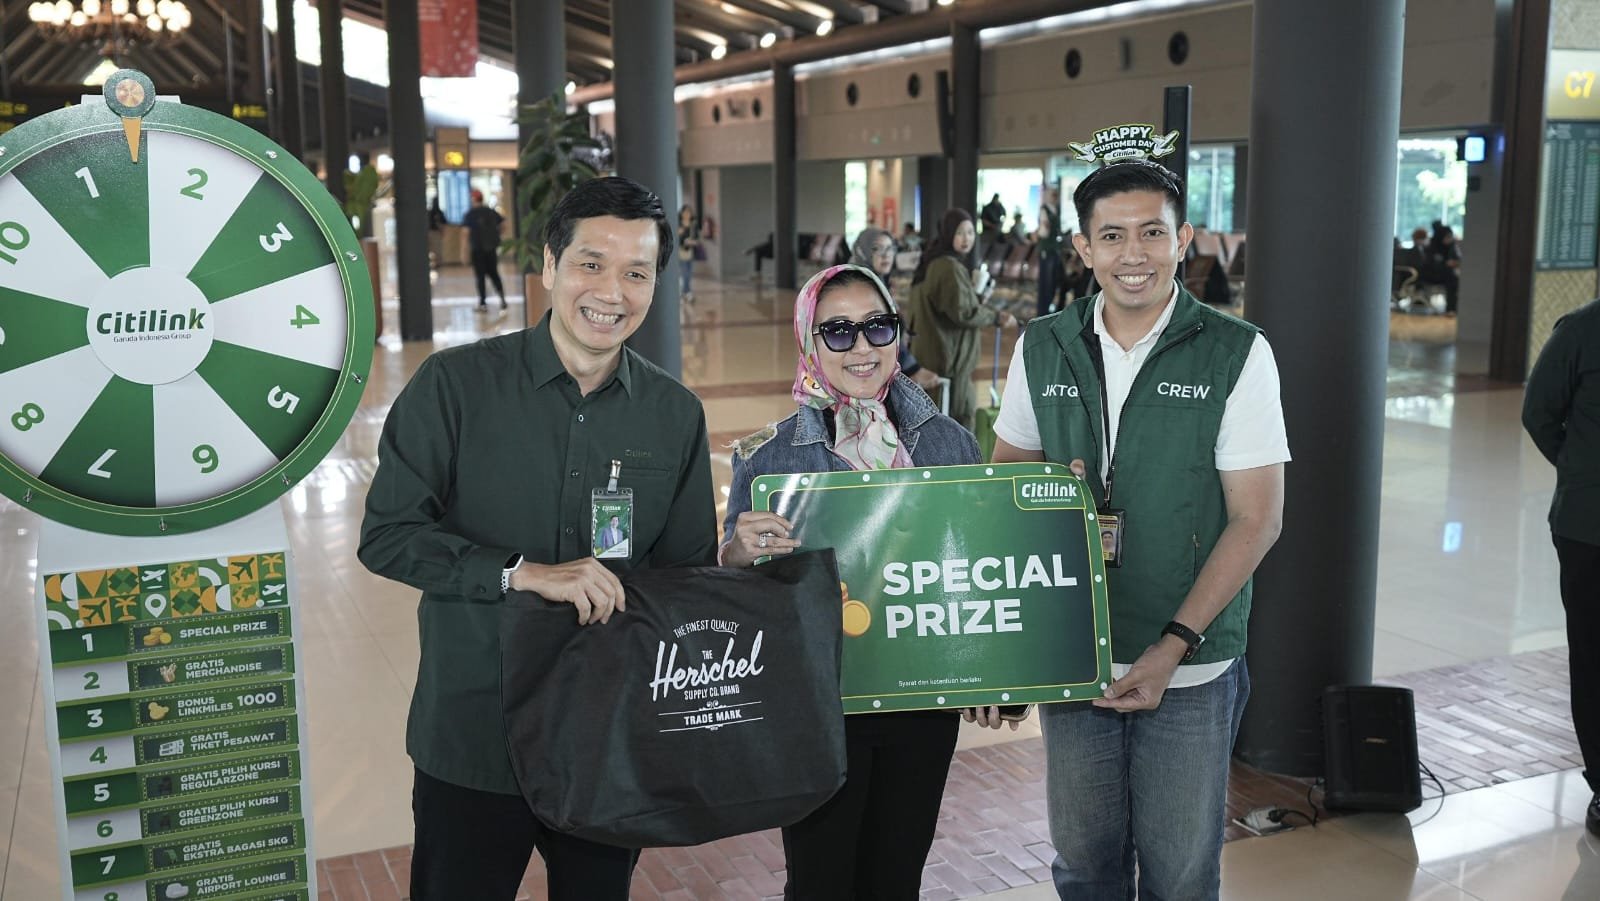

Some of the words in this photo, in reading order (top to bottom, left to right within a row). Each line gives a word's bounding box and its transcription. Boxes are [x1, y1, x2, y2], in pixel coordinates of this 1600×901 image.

[1564, 70, 1596, 98] C7
[1096, 126, 1151, 144] HAPPY
[1093, 139, 1137, 153] CUSTOMER
[1138, 140, 1155, 148] DAY
[75, 166, 100, 199] 1
[180, 168, 209, 201] 2
[259, 221, 294, 253] 3
[96, 308, 206, 335] Citilink
[290, 304, 320, 329] 4
[171, 332, 192, 341] Group
[267, 385, 300, 415] 5
[1157, 381, 1211, 400] CREW
[11, 402, 45, 432] 8
[87, 448, 118, 478] 7
[1021, 482, 1078, 498] Citilink
[883, 553, 1078, 597] SPECIAL
[885, 598, 1023, 639] PRIZE
[180, 626, 230, 639] SPECIAL
[233, 621, 267, 632] PRIZE
[673, 626, 686, 638] THE
[685, 619, 709, 633] FINEST
[710, 619, 740, 635] QUALITY
[81, 633, 93, 652] 1
[701, 649, 713, 660] THE
[186, 659, 225, 671] GRATIS
[186, 662, 262, 679] MERCHANDISE
[649, 629, 764, 702] Herschel
[83, 672, 100, 690] 2
[237, 692, 276, 706] 1000
[684, 688, 708, 700] SUPPLY
[709, 687, 719, 697] CO.
[720, 684, 740, 695] BRAND
[178, 696, 215, 708] BONUS
[178, 702, 233, 717] LINKMILES
[87, 709, 103, 728] 3
[684, 713, 713, 726] TRADE
[715, 709, 742, 720] MARK
[190, 731, 229, 743] GRATIS
[191, 738, 221, 751] TIKET
[224, 732, 275, 747] PESAWAT
[89, 746, 107, 764] 4
[180, 771, 220, 783] GRATIS
[222, 765, 249, 776] PILIH
[250, 760, 281, 771] KURSI
[181, 772, 259, 791] REGULARZONE
[94, 783, 110, 802] 5
[179, 806, 217, 818] GRATIS
[219, 801, 246, 812] PILIH
[248, 796, 279, 807] KURSI
[180, 810, 244, 827] GREENZONE
[97, 820, 113, 838] 6
[183, 840, 221, 853] GRATIS
[184, 848, 225, 862] EKSTRA
[227, 841, 266, 854] BAGASI
[268, 837, 288, 847] 5KG
[100, 856, 116, 875] 7
[196, 874, 234, 887] GRATIS
[197, 881, 242, 895] AIRPORT
[245, 872, 287, 886] LOUNGE
